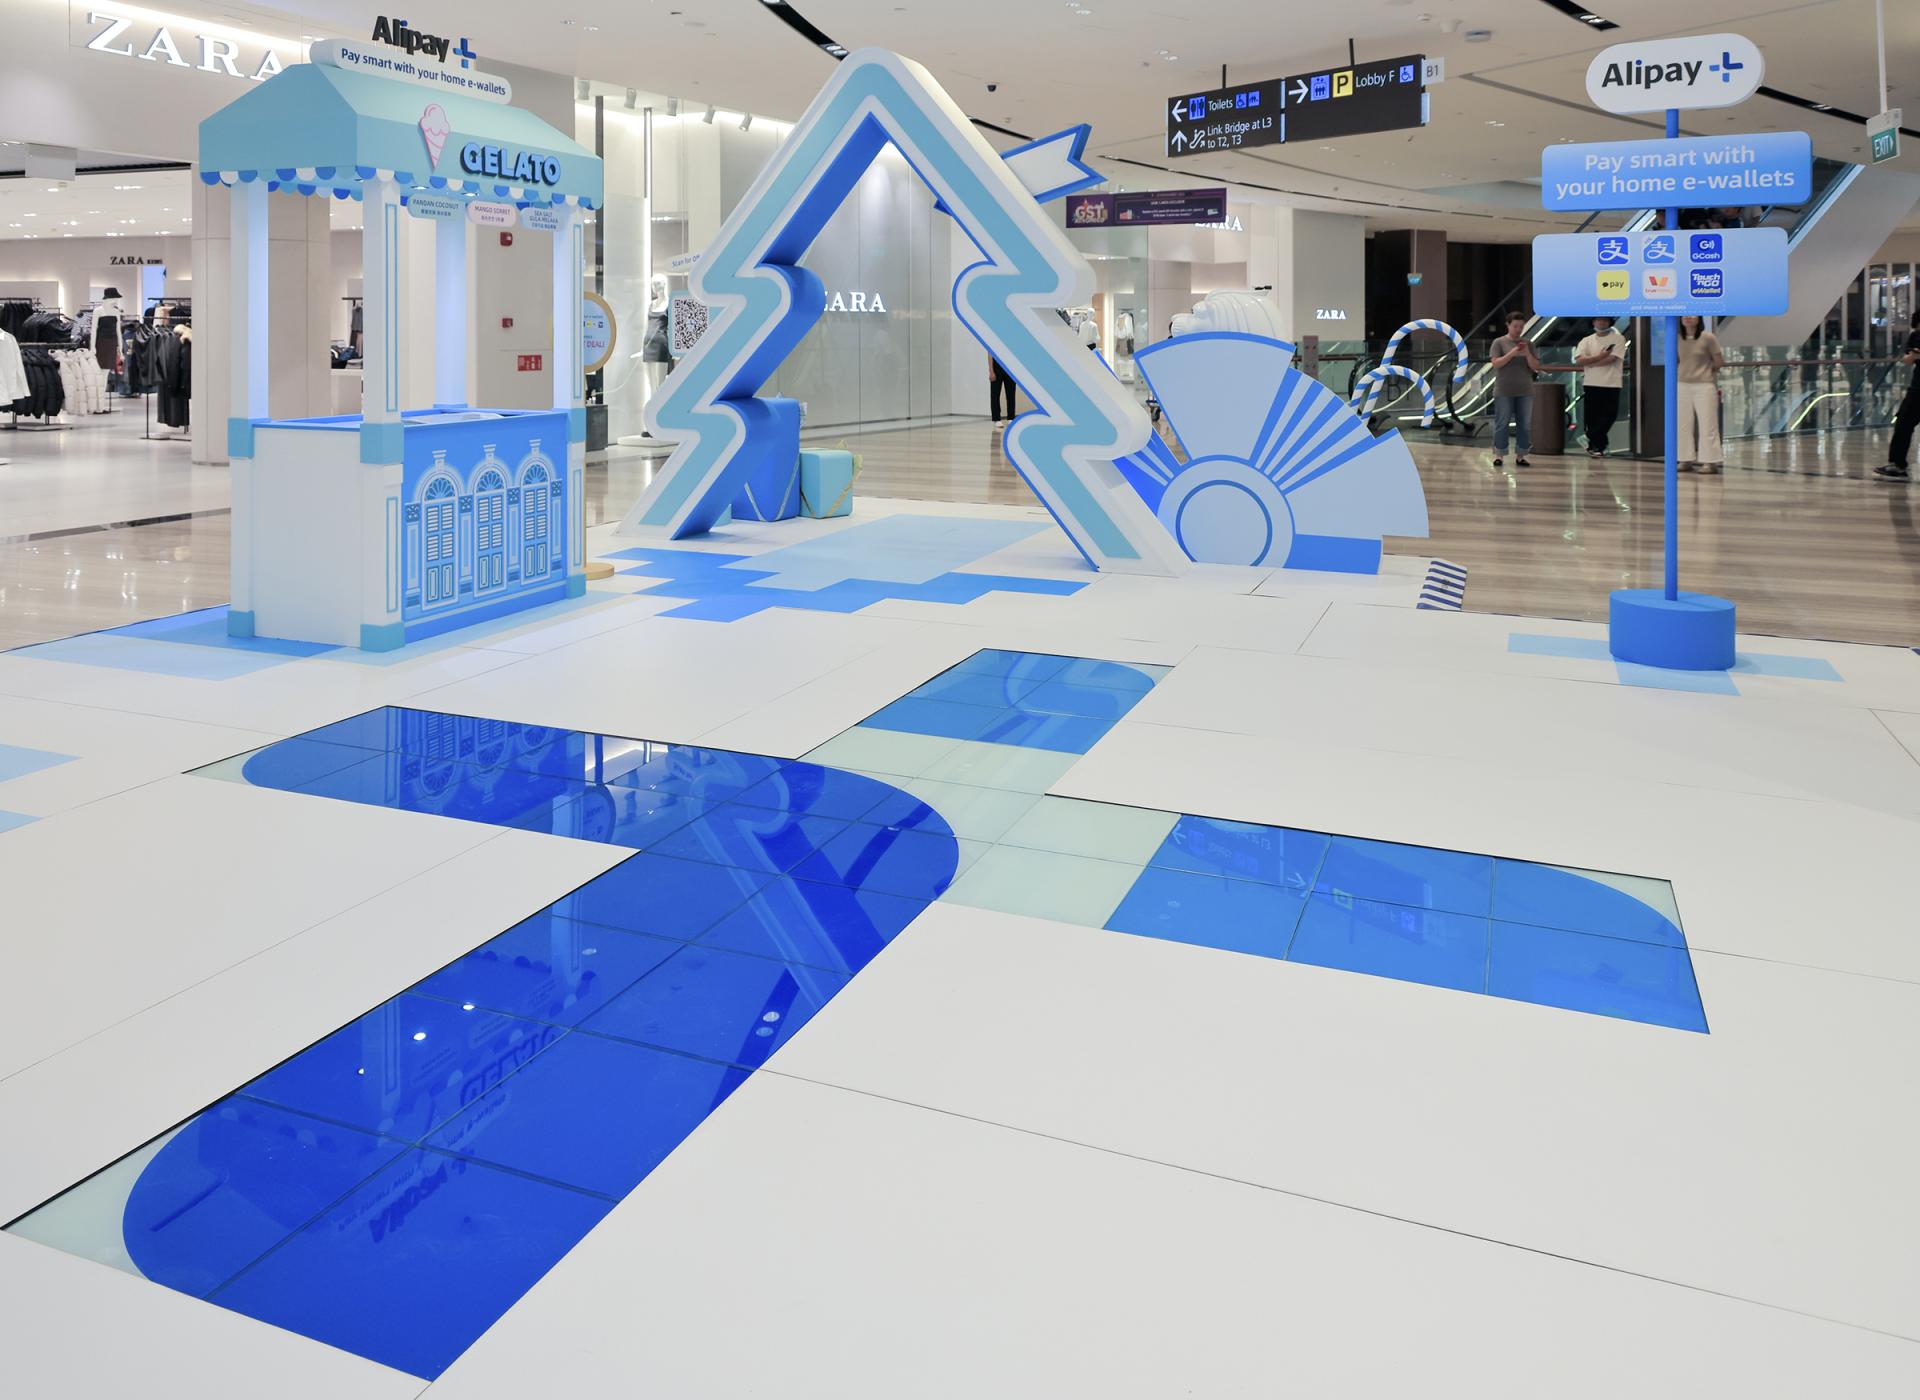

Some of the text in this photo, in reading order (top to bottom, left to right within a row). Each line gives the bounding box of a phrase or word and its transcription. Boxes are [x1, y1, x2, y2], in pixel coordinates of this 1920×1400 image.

[87, 11, 283, 81] ZARA
[341, 48, 506, 96] Pay smart with your home e-wallets
[1337, 71, 1395, 91] P Lobby F
[1426, 64, 1439, 78] B1
[1208, 99, 1233, 111] Toilets
[1207, 117, 1272, 136] Link Bridge at L3
[1207, 135, 1242, 149] to T2, T3
[1874, 134, 1889, 158] EXIT
[460, 141, 562, 186] GELATO
[1585, 144, 1755, 173] Pay smart with
[1556, 169, 1795, 200] your home e-wallets
[110, 256, 144, 265] ZARA
[1316, 309, 1347, 320] ZARA
